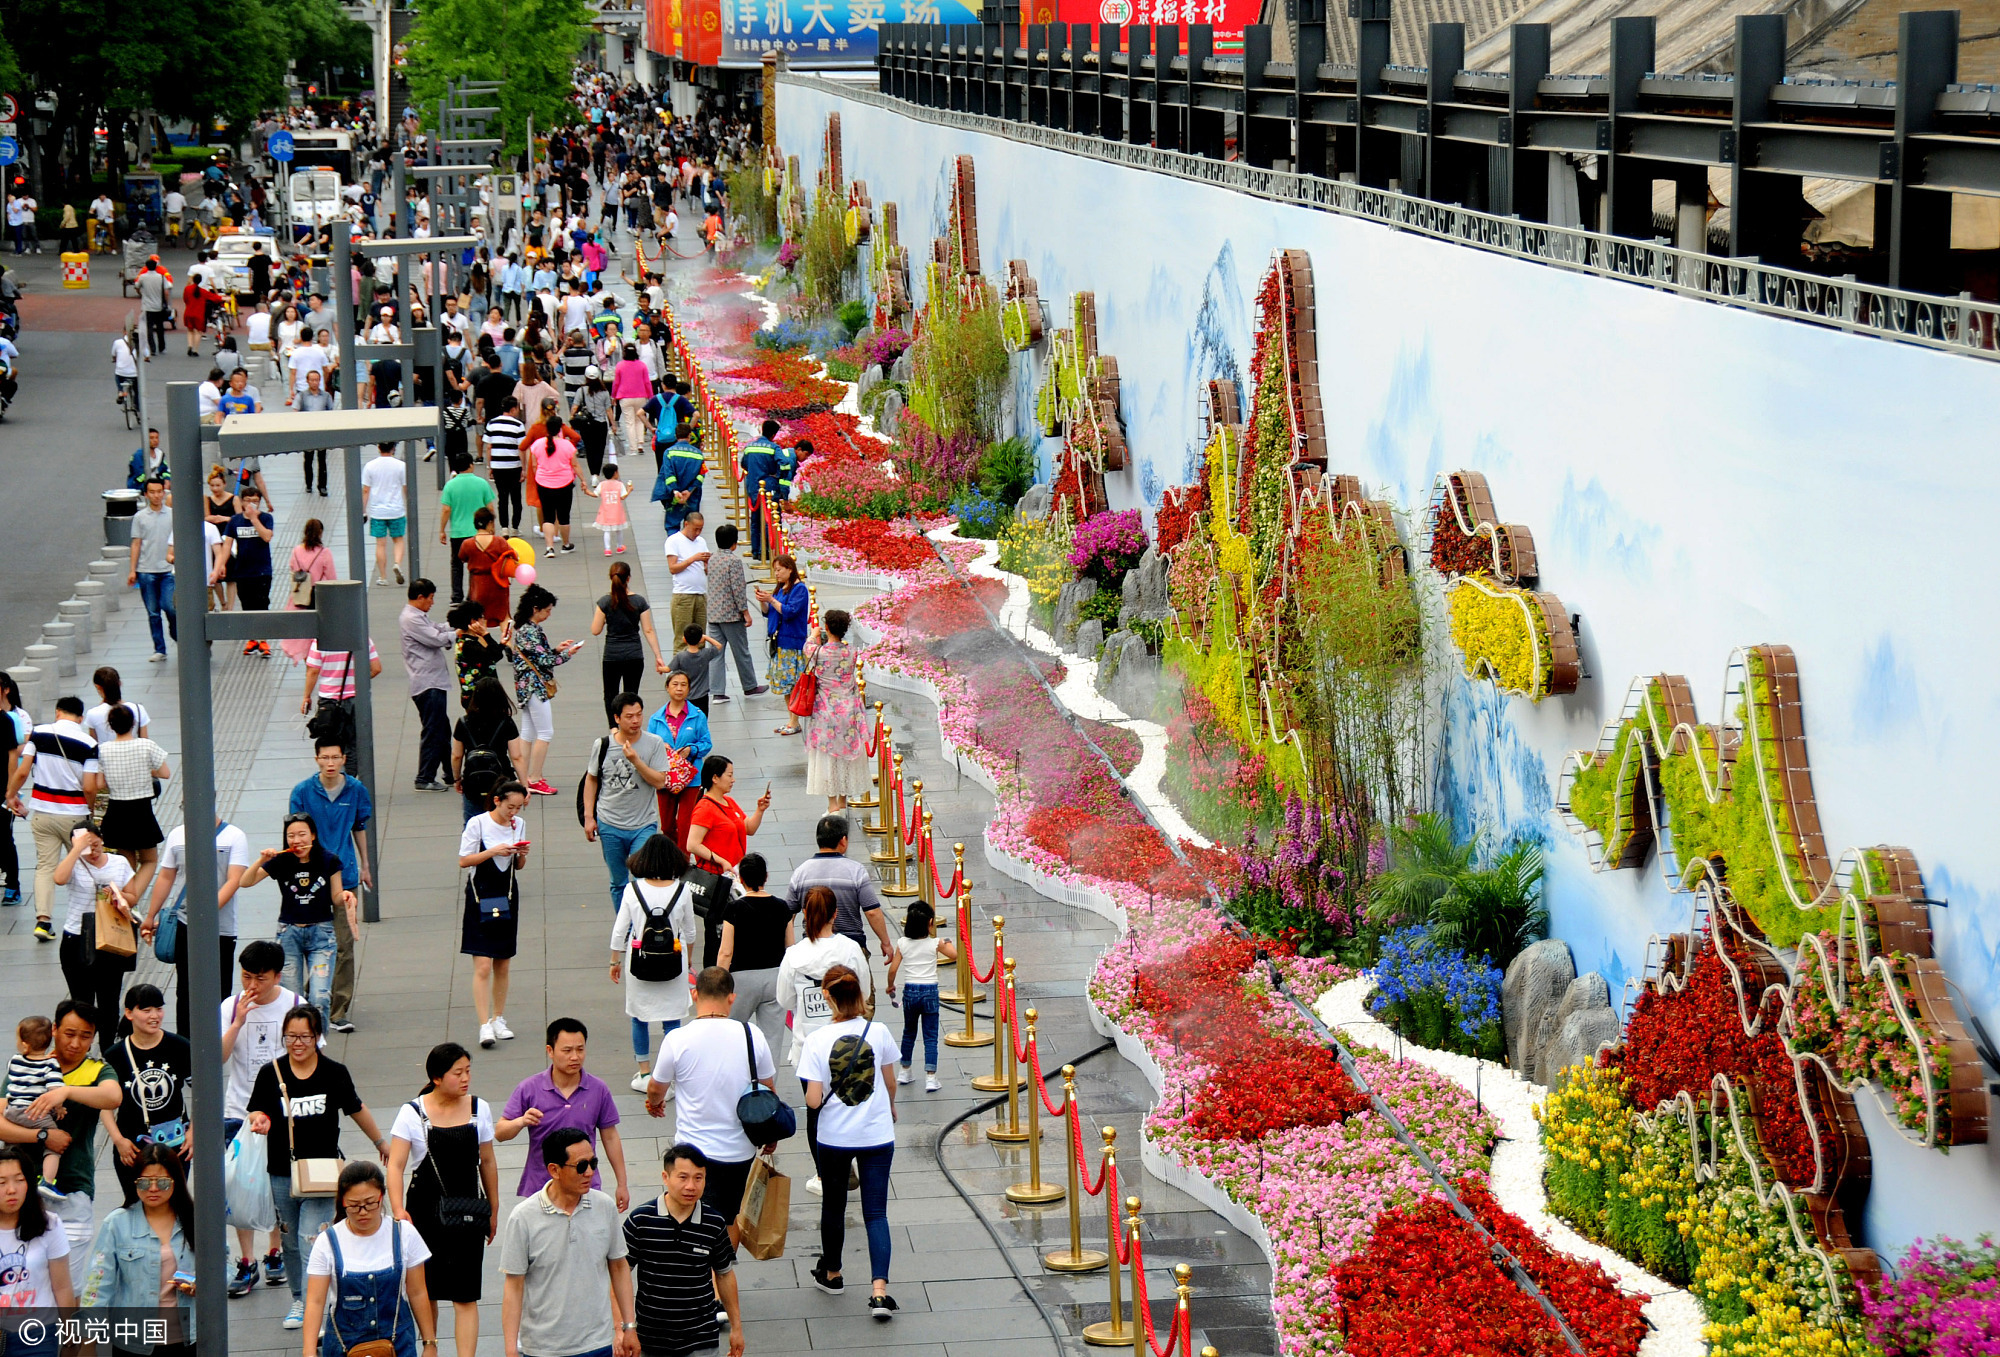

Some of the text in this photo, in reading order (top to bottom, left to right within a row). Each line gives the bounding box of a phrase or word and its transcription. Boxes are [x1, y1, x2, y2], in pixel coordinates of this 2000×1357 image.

[1137, 0, 1227, 25] 北京 稻香村
[806, 992, 826, 1003] TO
[281, 1094, 327, 1117] VANS
